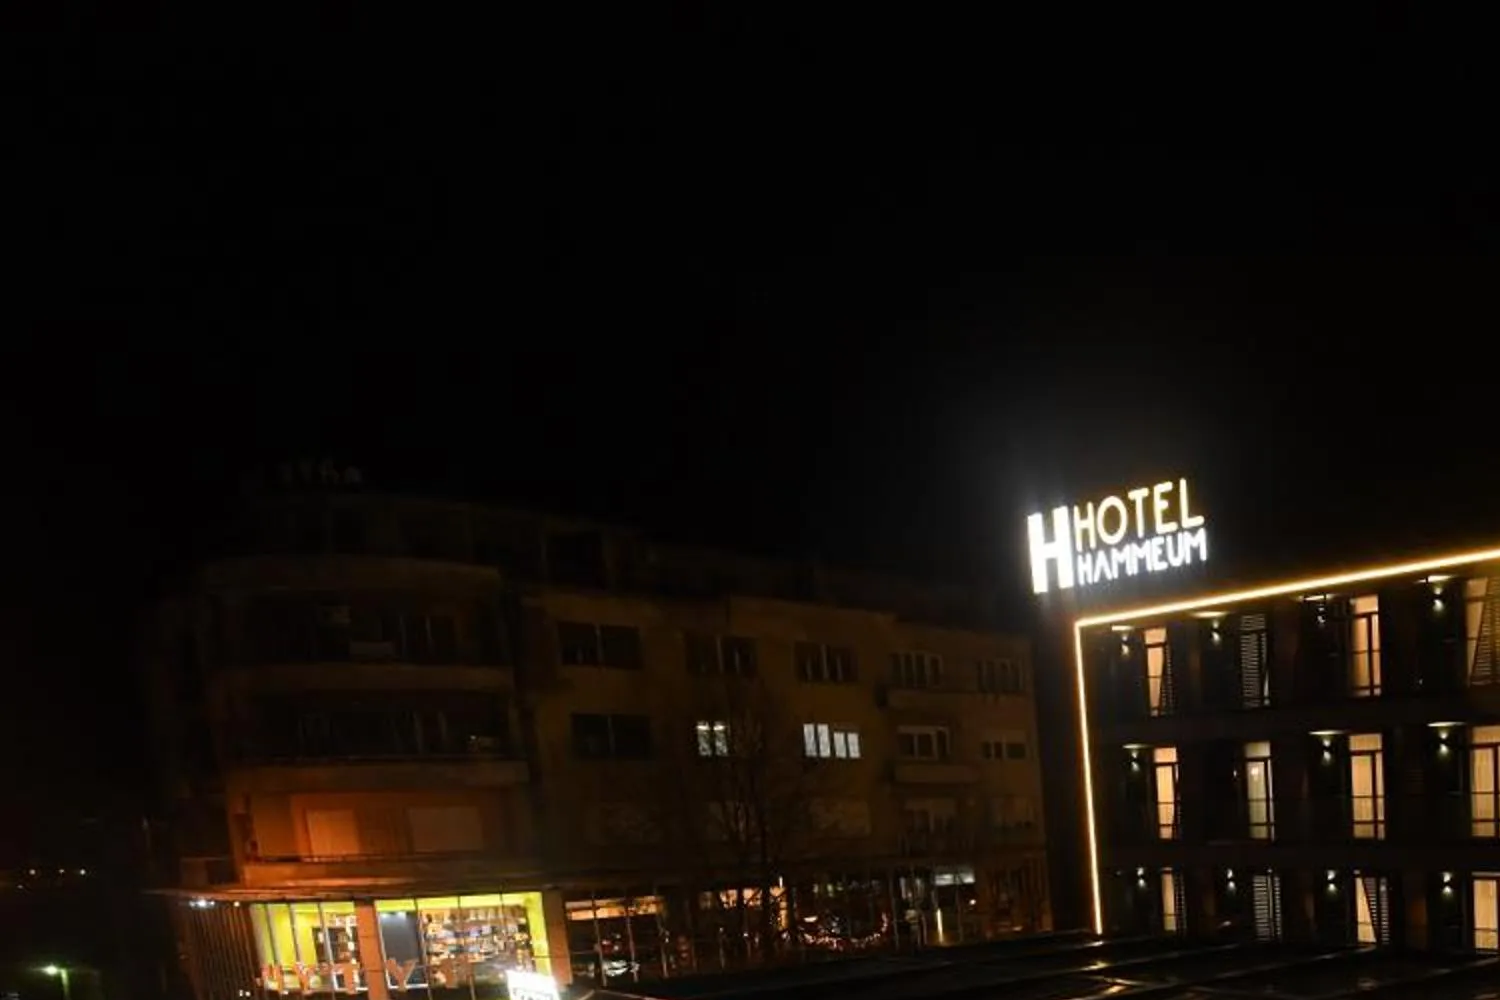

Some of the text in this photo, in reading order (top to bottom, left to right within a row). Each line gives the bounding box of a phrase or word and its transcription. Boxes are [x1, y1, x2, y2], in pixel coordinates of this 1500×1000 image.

[1027, 505, 1074, 593] H
[1074, 478, 1204, 551] HOTEL
[1077, 528, 1207, 585] HAMMEUM
